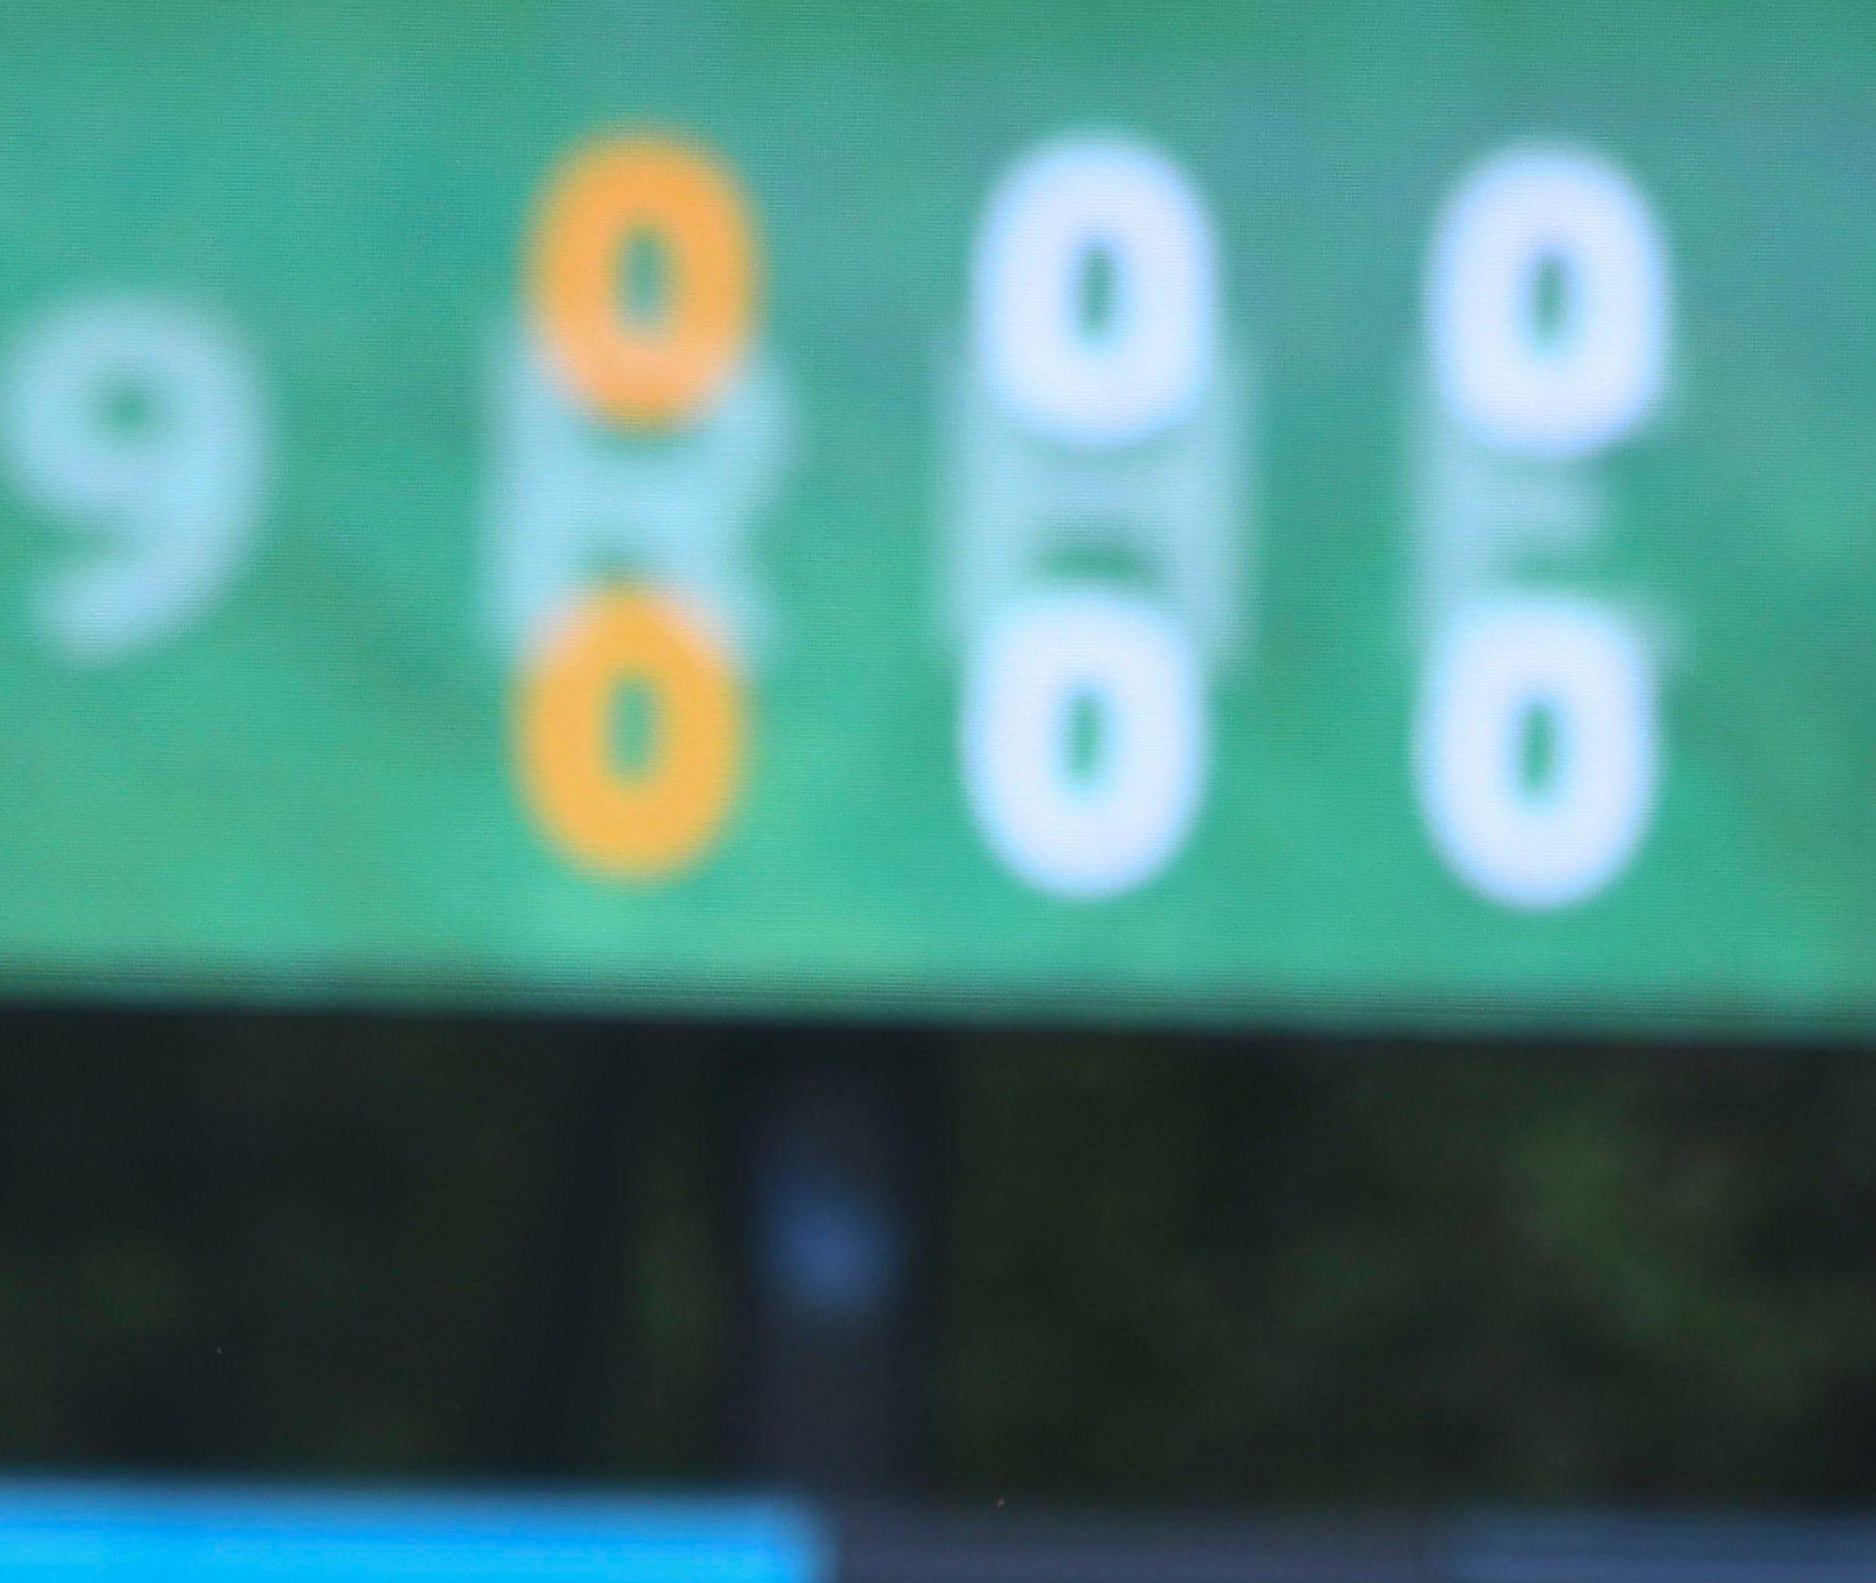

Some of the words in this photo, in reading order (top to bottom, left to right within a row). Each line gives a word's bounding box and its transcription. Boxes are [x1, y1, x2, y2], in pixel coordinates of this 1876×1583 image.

[522, 126, 763, 431] 0
[974, 134, 1217, 446] 0
[1427, 141, 1669, 454] 0
[511, 577, 751, 882] 0
[962, 589, 1206, 896] 0
[1417, 595, 1656, 908] 0
